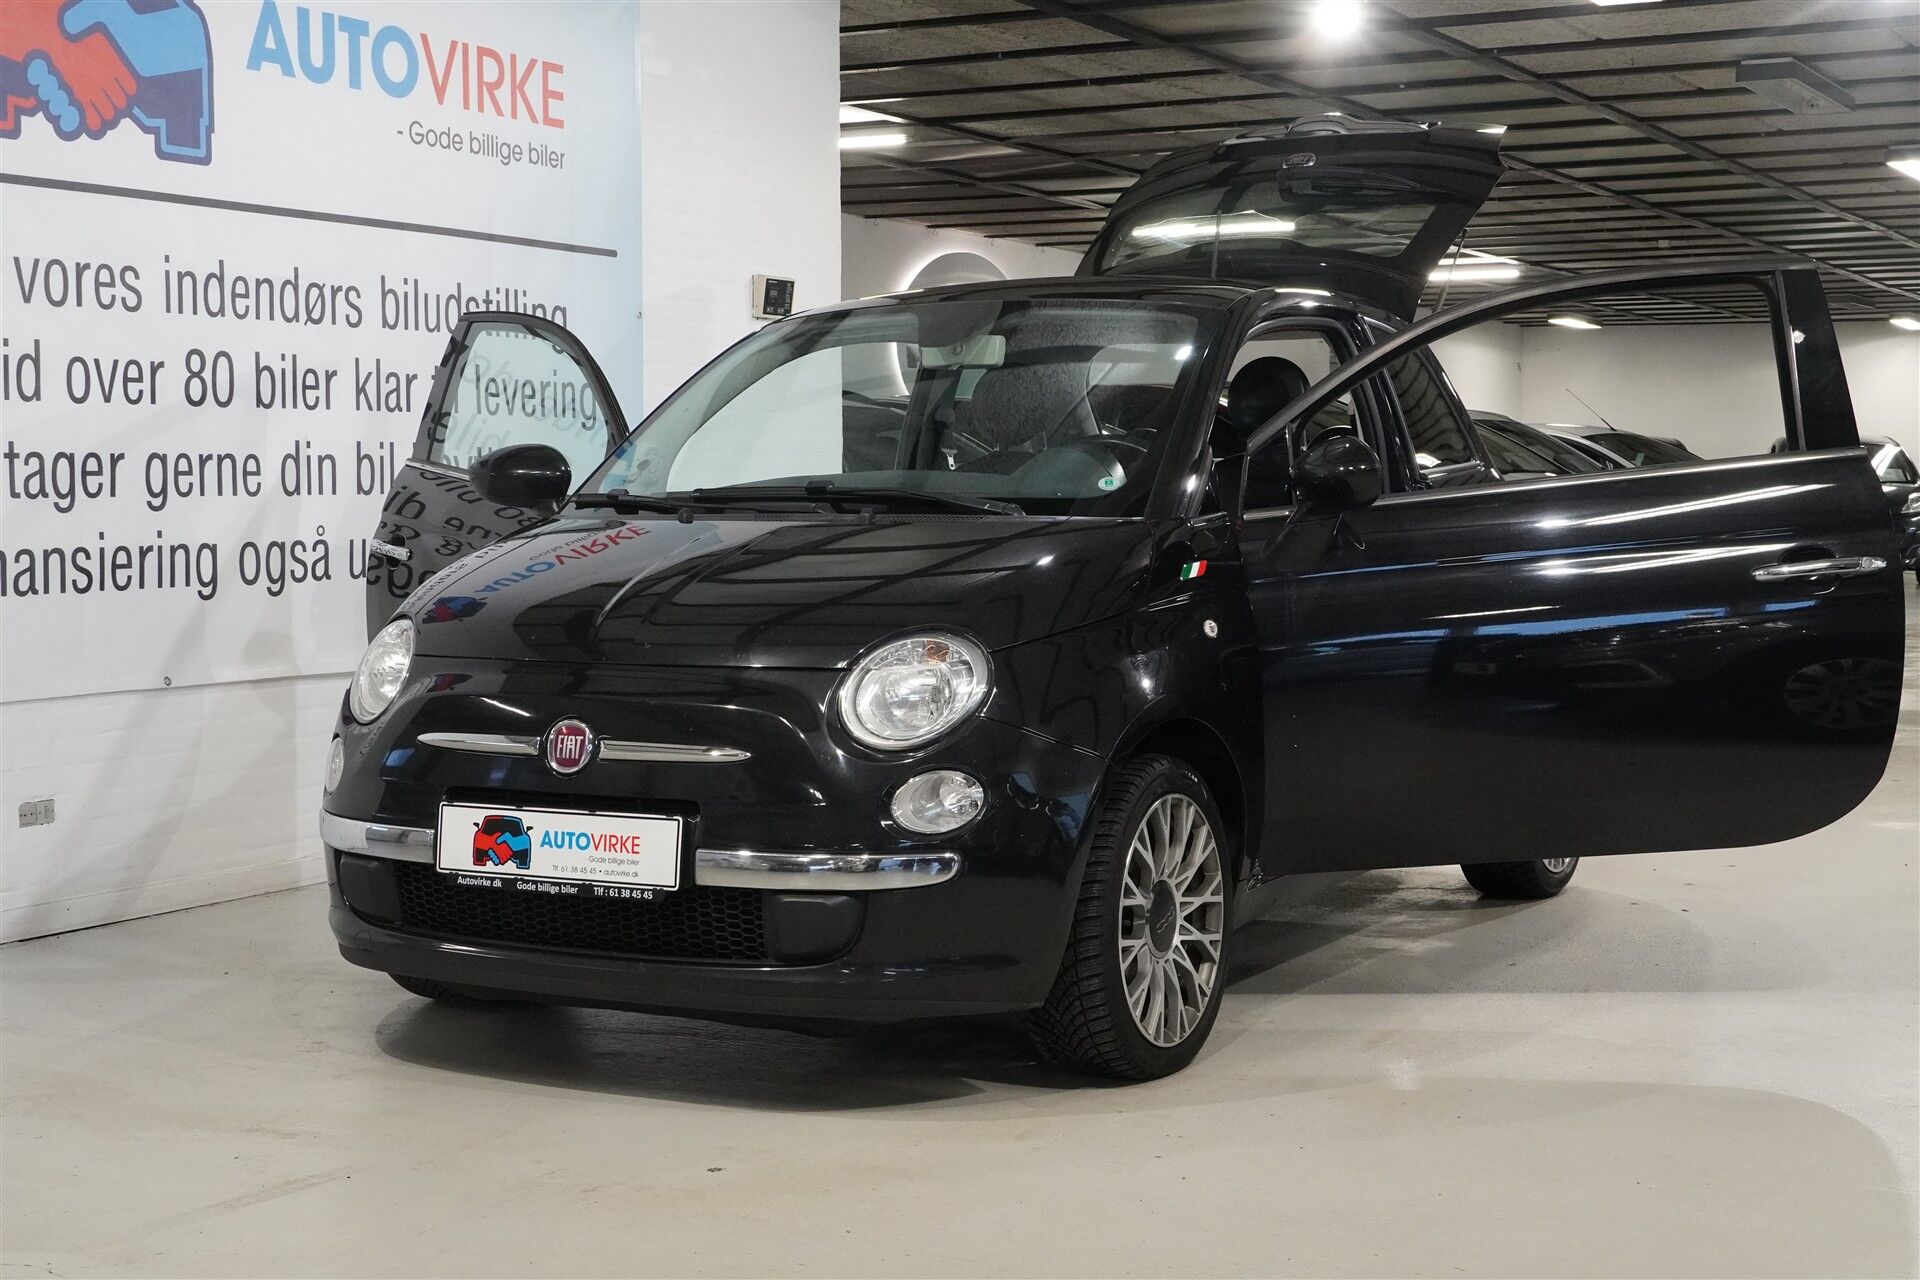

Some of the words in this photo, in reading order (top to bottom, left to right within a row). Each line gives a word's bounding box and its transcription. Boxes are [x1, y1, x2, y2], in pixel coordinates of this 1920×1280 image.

[246, 0, 565, 129] AUTOVIRKE
[408, 121, 463, 152] Gode
[469, 130, 523, 165] billige
[528, 141, 565, 170] biler
[13, 256, 142, 313] vores
[164, 254, 363, 329] indendørs
[3, 337, 42, 403] id
[65, 355, 165, 405] over
[183, 347, 235, 409] 80
[254, 351, 338, 411] biler
[354, 357, 418, 413] klar
[475, 363, 597, 431] levering
[3, 440, 125, 514] tager
[145, 451, 262, 513] gerne
[281, 438, 337, 498] din
[356, 441, 395, 496] bil
[238, 524, 331, 597] også
[556, 734, 584, 760] FIAT
[540, 830, 640, 854] AUTOVIRKE
[588, 855, 607, 864] Gode
[457, 876, 491, 887] Autovirke
[516, 881, 537, 891] Gode
[537, 883, 560, 895] billige
[561, 884, 579, 895] biler
[609, 888, 619, 897] 61
[620, 889, 630, 898] 38
[631, 890, 641, 899] 45
[642, 890, 653, 900] 45
[561, 865, 568, 873] 61
[570, 865, 578, 874] 38
[580, 866, 587, 875] 45
[589, 867, 597, 875] 45
